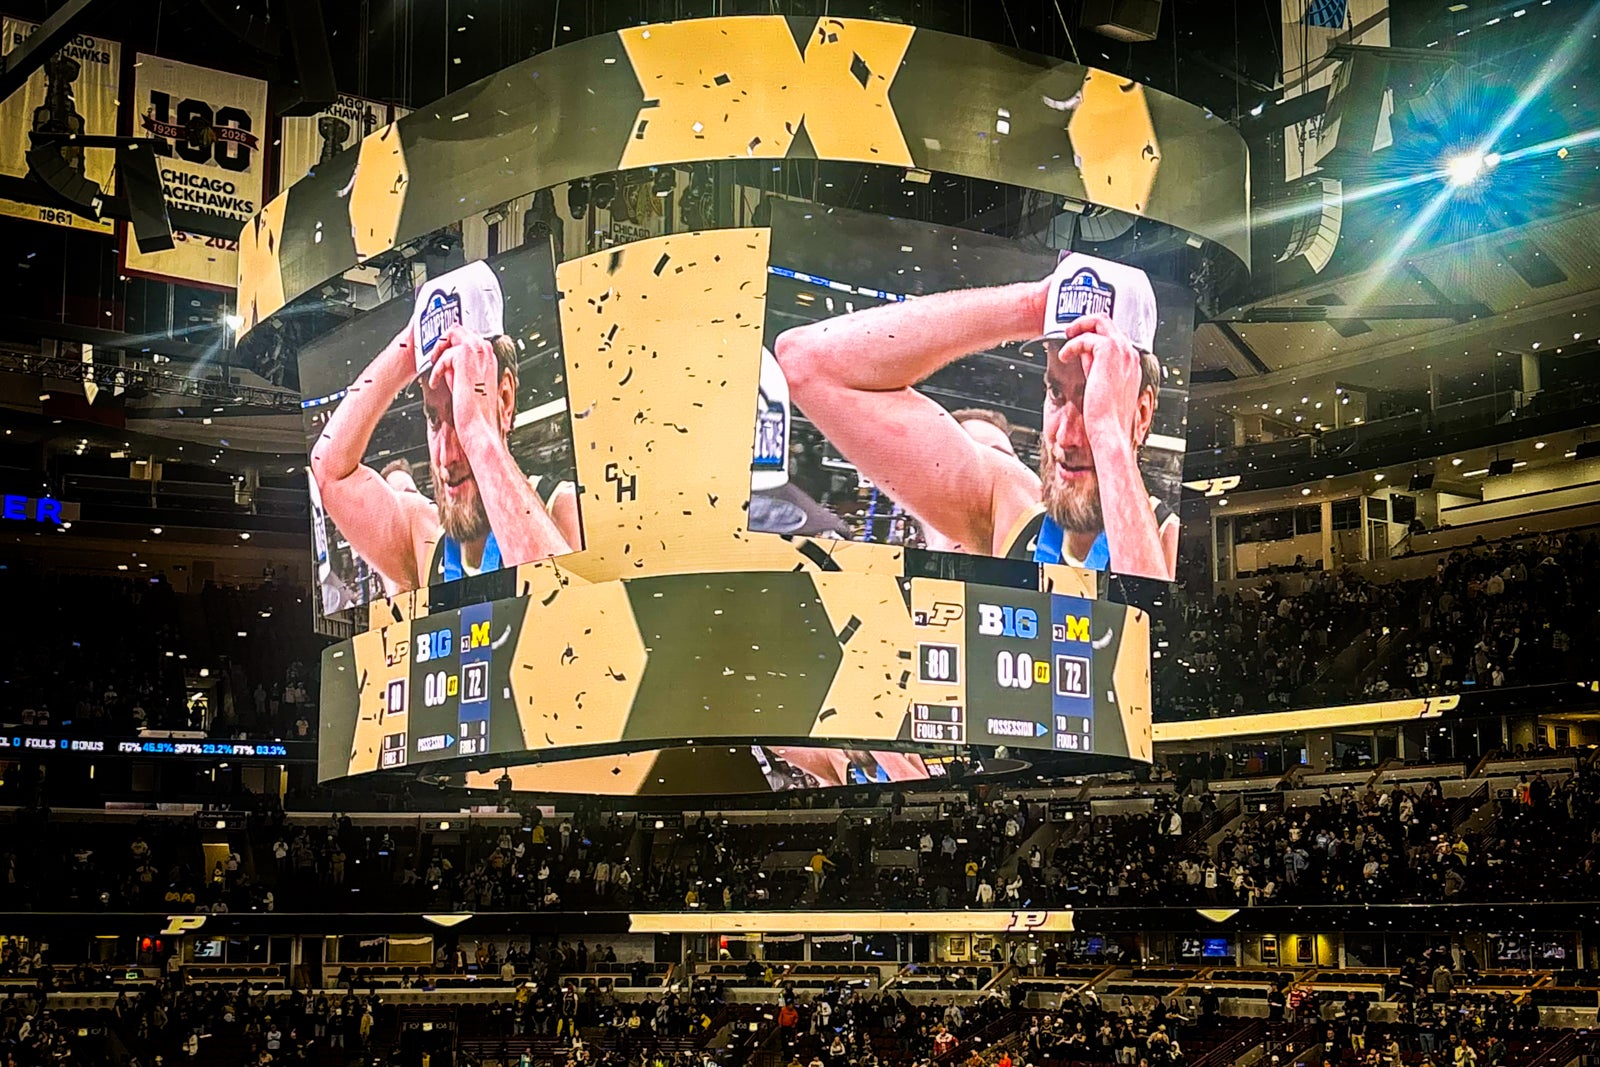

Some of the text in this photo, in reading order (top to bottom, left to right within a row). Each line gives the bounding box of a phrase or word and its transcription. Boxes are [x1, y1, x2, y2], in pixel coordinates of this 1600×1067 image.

[152, 123, 178, 137] 1926
[221, 128, 247, 141] 2026
[160, 168, 235, 195] CHICAGO
[39, 209, 73, 225] 1961
[927, 602, 964, 627] P
[470, 621, 490, 648] M
[1065, 614, 1091, 643] M
[928, 648, 950, 680] 80
[997, 650, 1033, 689] 0.0
[424, 670, 447, 708] 0.0
[468, 667, 482, 698] 72
[1064, 661, 1081, 693] 72
[917, 704, 929, 720] TO
[917, 723, 943, 740] FOULS
[987, 718, 1034, 738] POSSESSION
[25, 738, 56, 749] FOULS
[71, 741, 104, 751] BONUS
[118, 742, 142, 752] FG%
[160, 916, 207, 935] P
